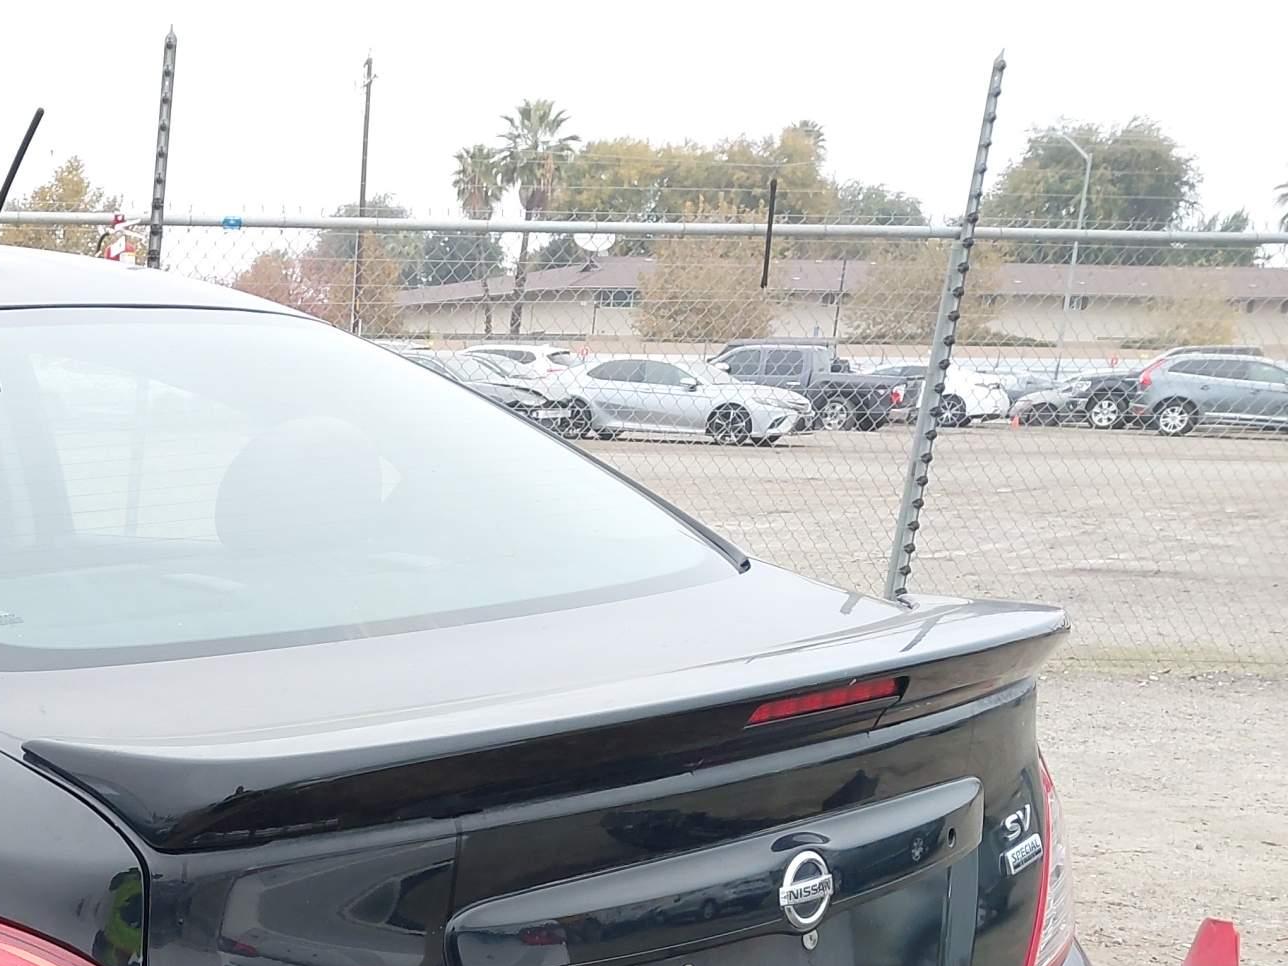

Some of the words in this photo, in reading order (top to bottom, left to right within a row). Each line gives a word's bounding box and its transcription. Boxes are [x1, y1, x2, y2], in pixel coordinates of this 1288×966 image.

[1004, 804, 1031, 841] SV
[1011, 839, 1041, 864] SPECIAL
[788, 878, 831, 902] NISSAN
